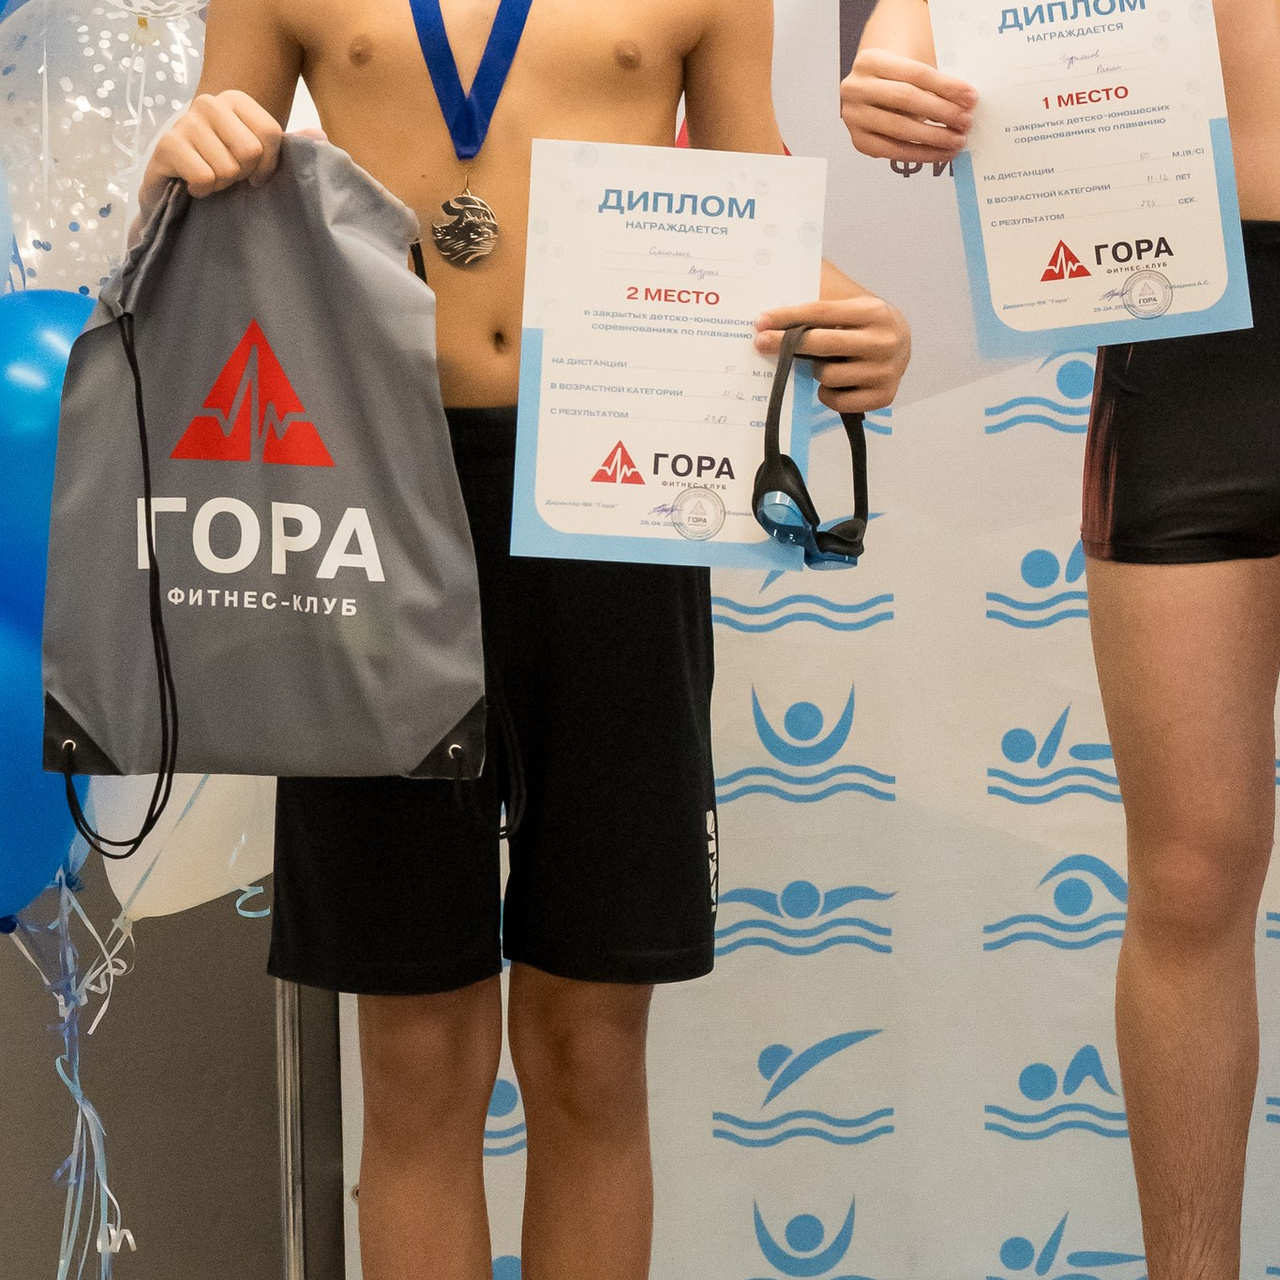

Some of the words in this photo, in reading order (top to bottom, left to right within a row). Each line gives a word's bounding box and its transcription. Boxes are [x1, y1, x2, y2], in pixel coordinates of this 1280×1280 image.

[1026, 22, 1124, 43] НАГРАЖДАЕТСЯ
[1042, 96, 1050, 110] 1
[1057, 85, 1129, 108] МЕСТО
[1013, 119, 1064, 133] закрытых
[1066, 104, 1170, 125] детско-юношеских
[1014, 127, 1096, 144] соревнованиях
[1098, 124, 1112, 134] по
[1112, 117, 1166, 131] плаванию
[983, 174, 996, 182] НА
[997, 167, 1055, 181] ДИСТАНЦИИ
[986, 197, 993, 205] В
[994, 190, 1057, 204] ВОЗРАСТНОЙ
[1057, 183, 1111, 197] КАТЕГОРИИ
[1175, 173, 1191, 181] ЛЕТ
[598, 189, 756, 219] ДИПЛОМ
[625, 220, 728, 235] НАГРАЖДАЕТСЯ
[998, 213, 1065, 227] РЕЗУЛЬТАТОМ
[1094, 236, 1174, 266] ГОРА
[1106, 262, 1168, 274] ФИТНЕС-КЛУБ
[626, 286, 639, 300] 2
[644, 287, 720, 306] МЕСТО
[583, 309, 591, 317] в
[592, 310, 647, 320] закрытых
[591, 323, 678, 335] соревнованиях
[696, 329, 753, 340] плаванию
[551, 357, 565, 365] НА
[567, 358, 628, 369] ДИСТАНЦИИ
[550, 382, 557, 390] В
[559, 382, 625, 393] ВОЗРАСТНОЙ
[626, 386, 683, 397] КАТЕГОРИИ
[558, 408, 629, 419] РЕЗУЛЬТАТОМ
[653, 453, 736, 480] ГОРА
[661, 480, 727, 490] ФИТНЕС-КЛУБ
[687, 516, 708, 524] ГОРА
[136, 496, 386, 582] ГОРА
[167, 587, 357, 617] ФИТНЕС-КЛУБ
